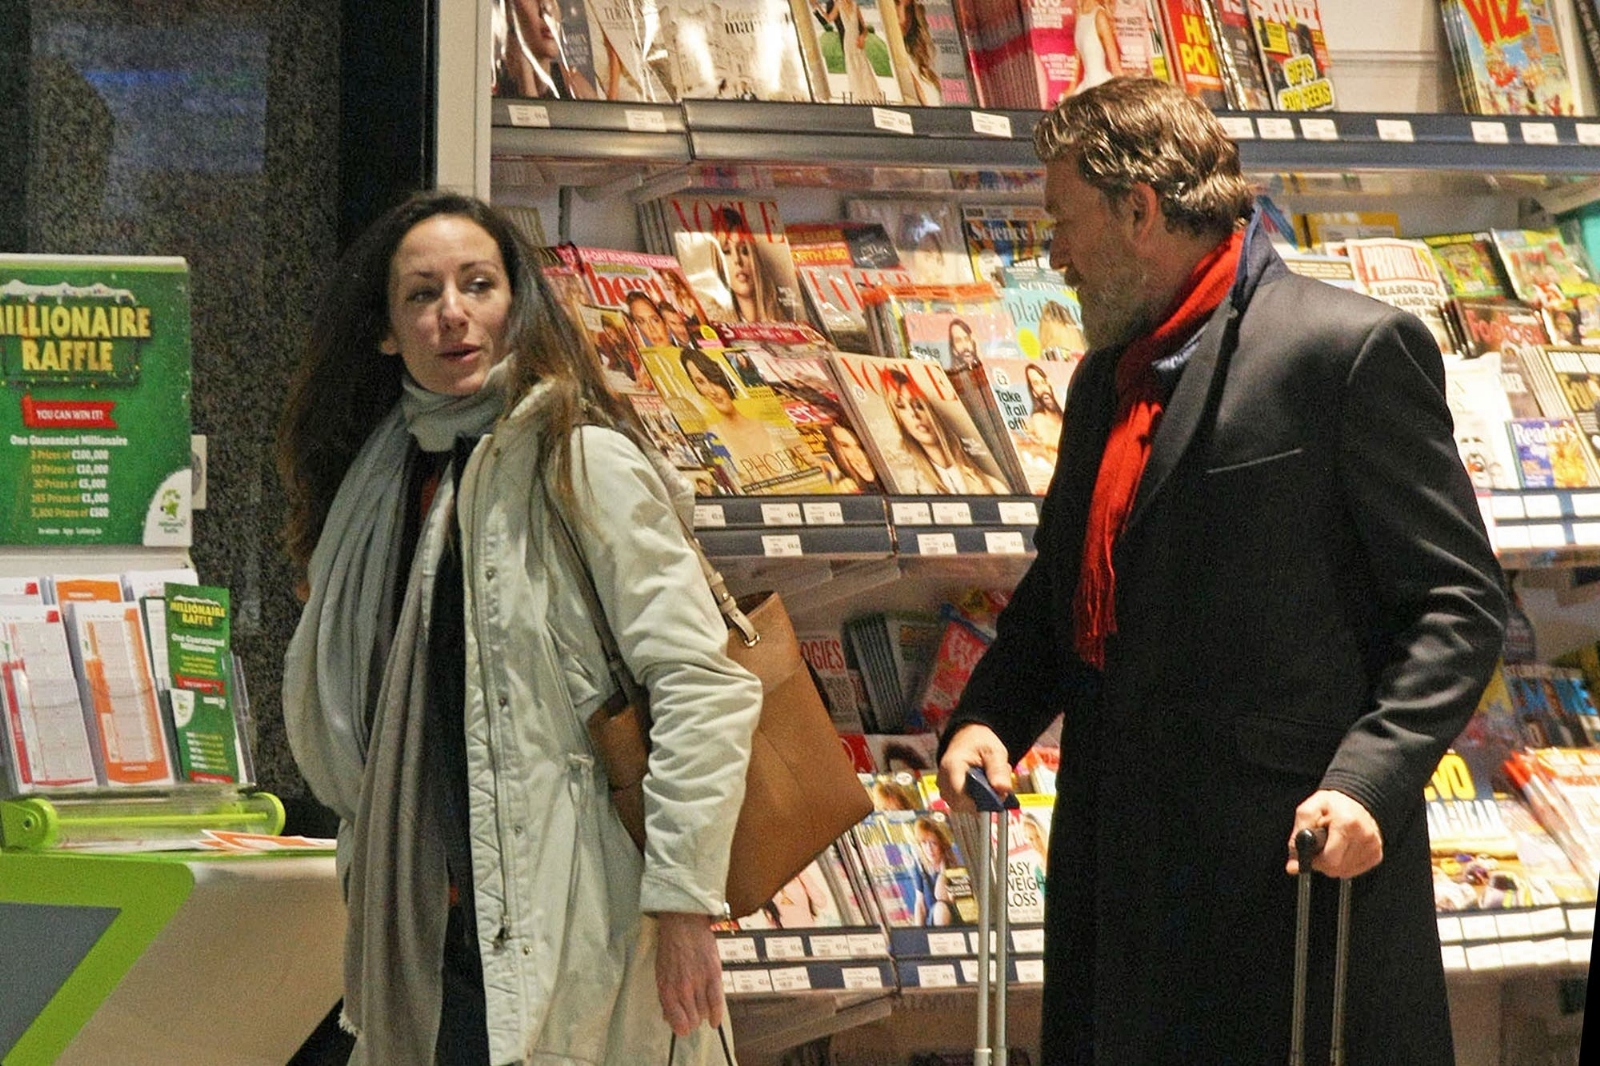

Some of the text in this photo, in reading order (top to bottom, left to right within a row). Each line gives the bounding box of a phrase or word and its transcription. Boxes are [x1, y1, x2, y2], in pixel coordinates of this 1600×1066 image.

[791, 249, 823, 263] ORTH
[21, 339, 114, 371] RAFFLE
[995, 389, 1022, 403] Take
[36, 409, 53, 420] YOU
[54, 409, 72, 420] CAN
[72, 410, 90, 420] WIN
[1004, 402, 1028, 416] it all
[10, 434, 128, 446] One Guaranteed Millionaire
[170, 601, 225, 618] MILLIONAIRE
[182, 613, 214, 627] RAFFLE
[1007, 861, 1031, 877] ASY
[1007, 875, 1045, 892] EIGH
